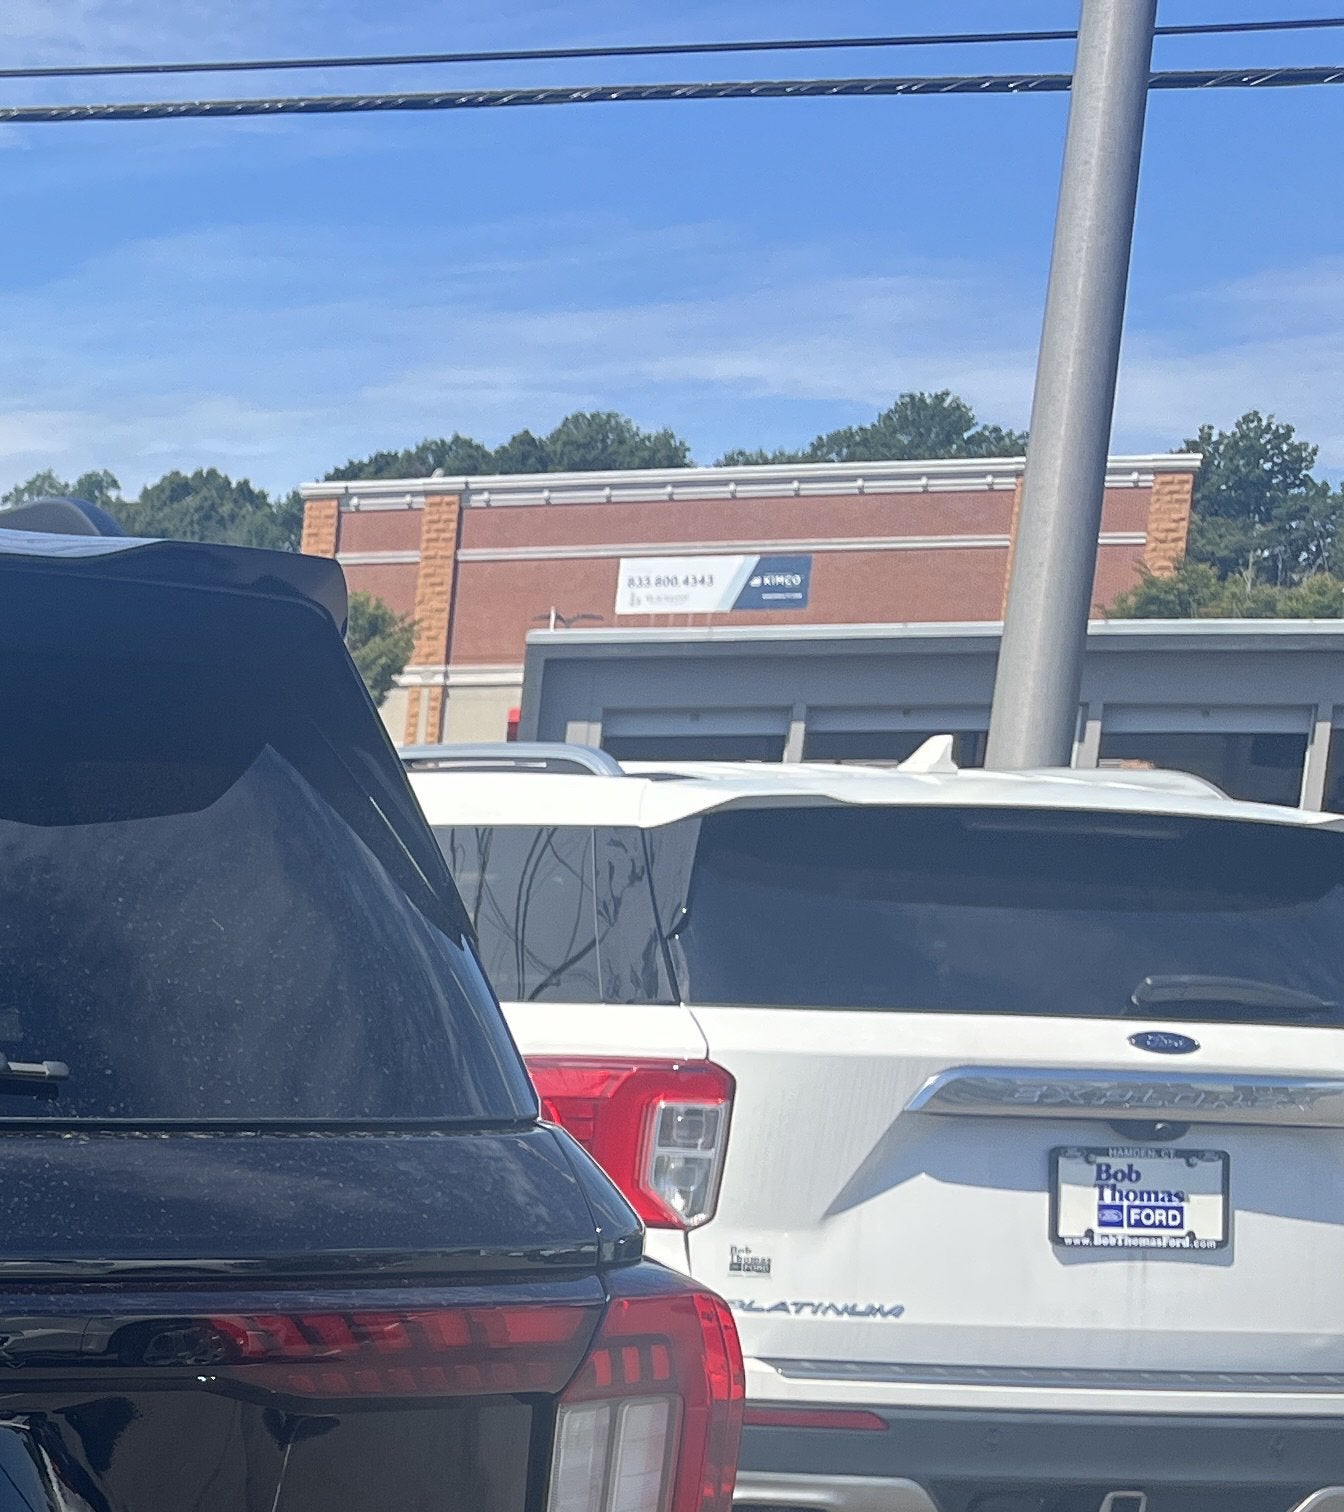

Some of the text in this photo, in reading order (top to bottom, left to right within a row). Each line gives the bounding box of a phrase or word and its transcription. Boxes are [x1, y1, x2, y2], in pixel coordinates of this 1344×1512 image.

[762, 574, 802, 586] KIMCO
[1095, 1162, 1142, 1183] Bob
[1094, 1182, 1186, 1203] Thomas
[1129, 1208, 1182, 1227] FORD
